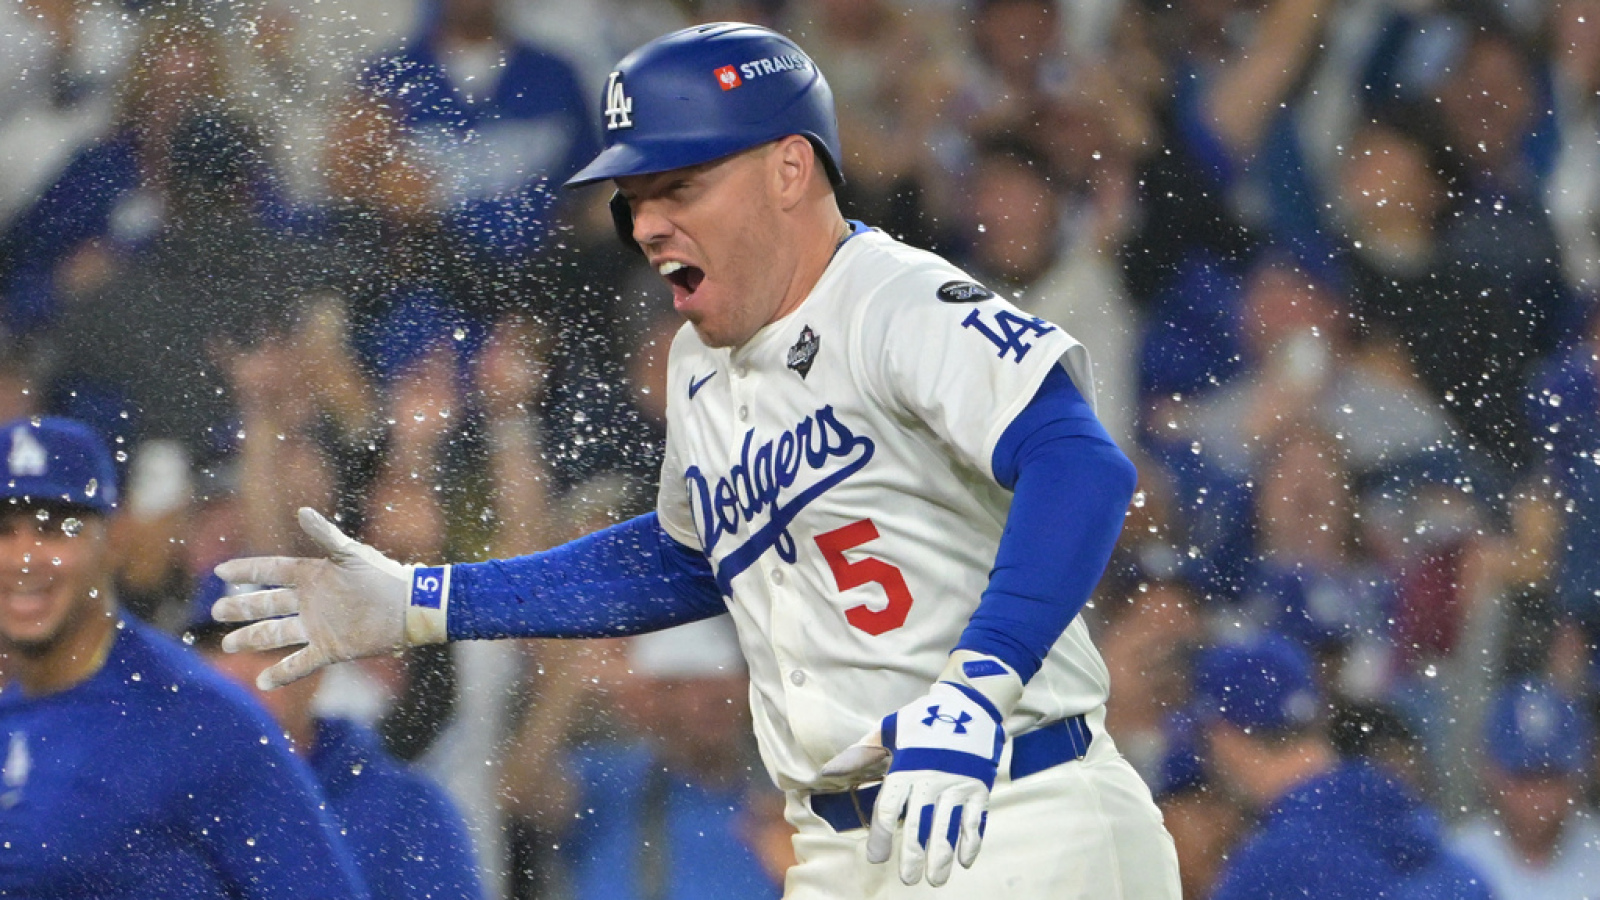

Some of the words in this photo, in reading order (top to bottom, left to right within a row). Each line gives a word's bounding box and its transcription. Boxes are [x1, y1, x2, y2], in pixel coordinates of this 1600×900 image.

[740, 56, 807, 79] STRAUS
[605, 71, 632, 130] LA
[961, 308, 1056, 364] LA
[685, 404, 875, 566] Dodgers
[416, 575, 439, 592] 5
[813, 518, 914, 636] 5
